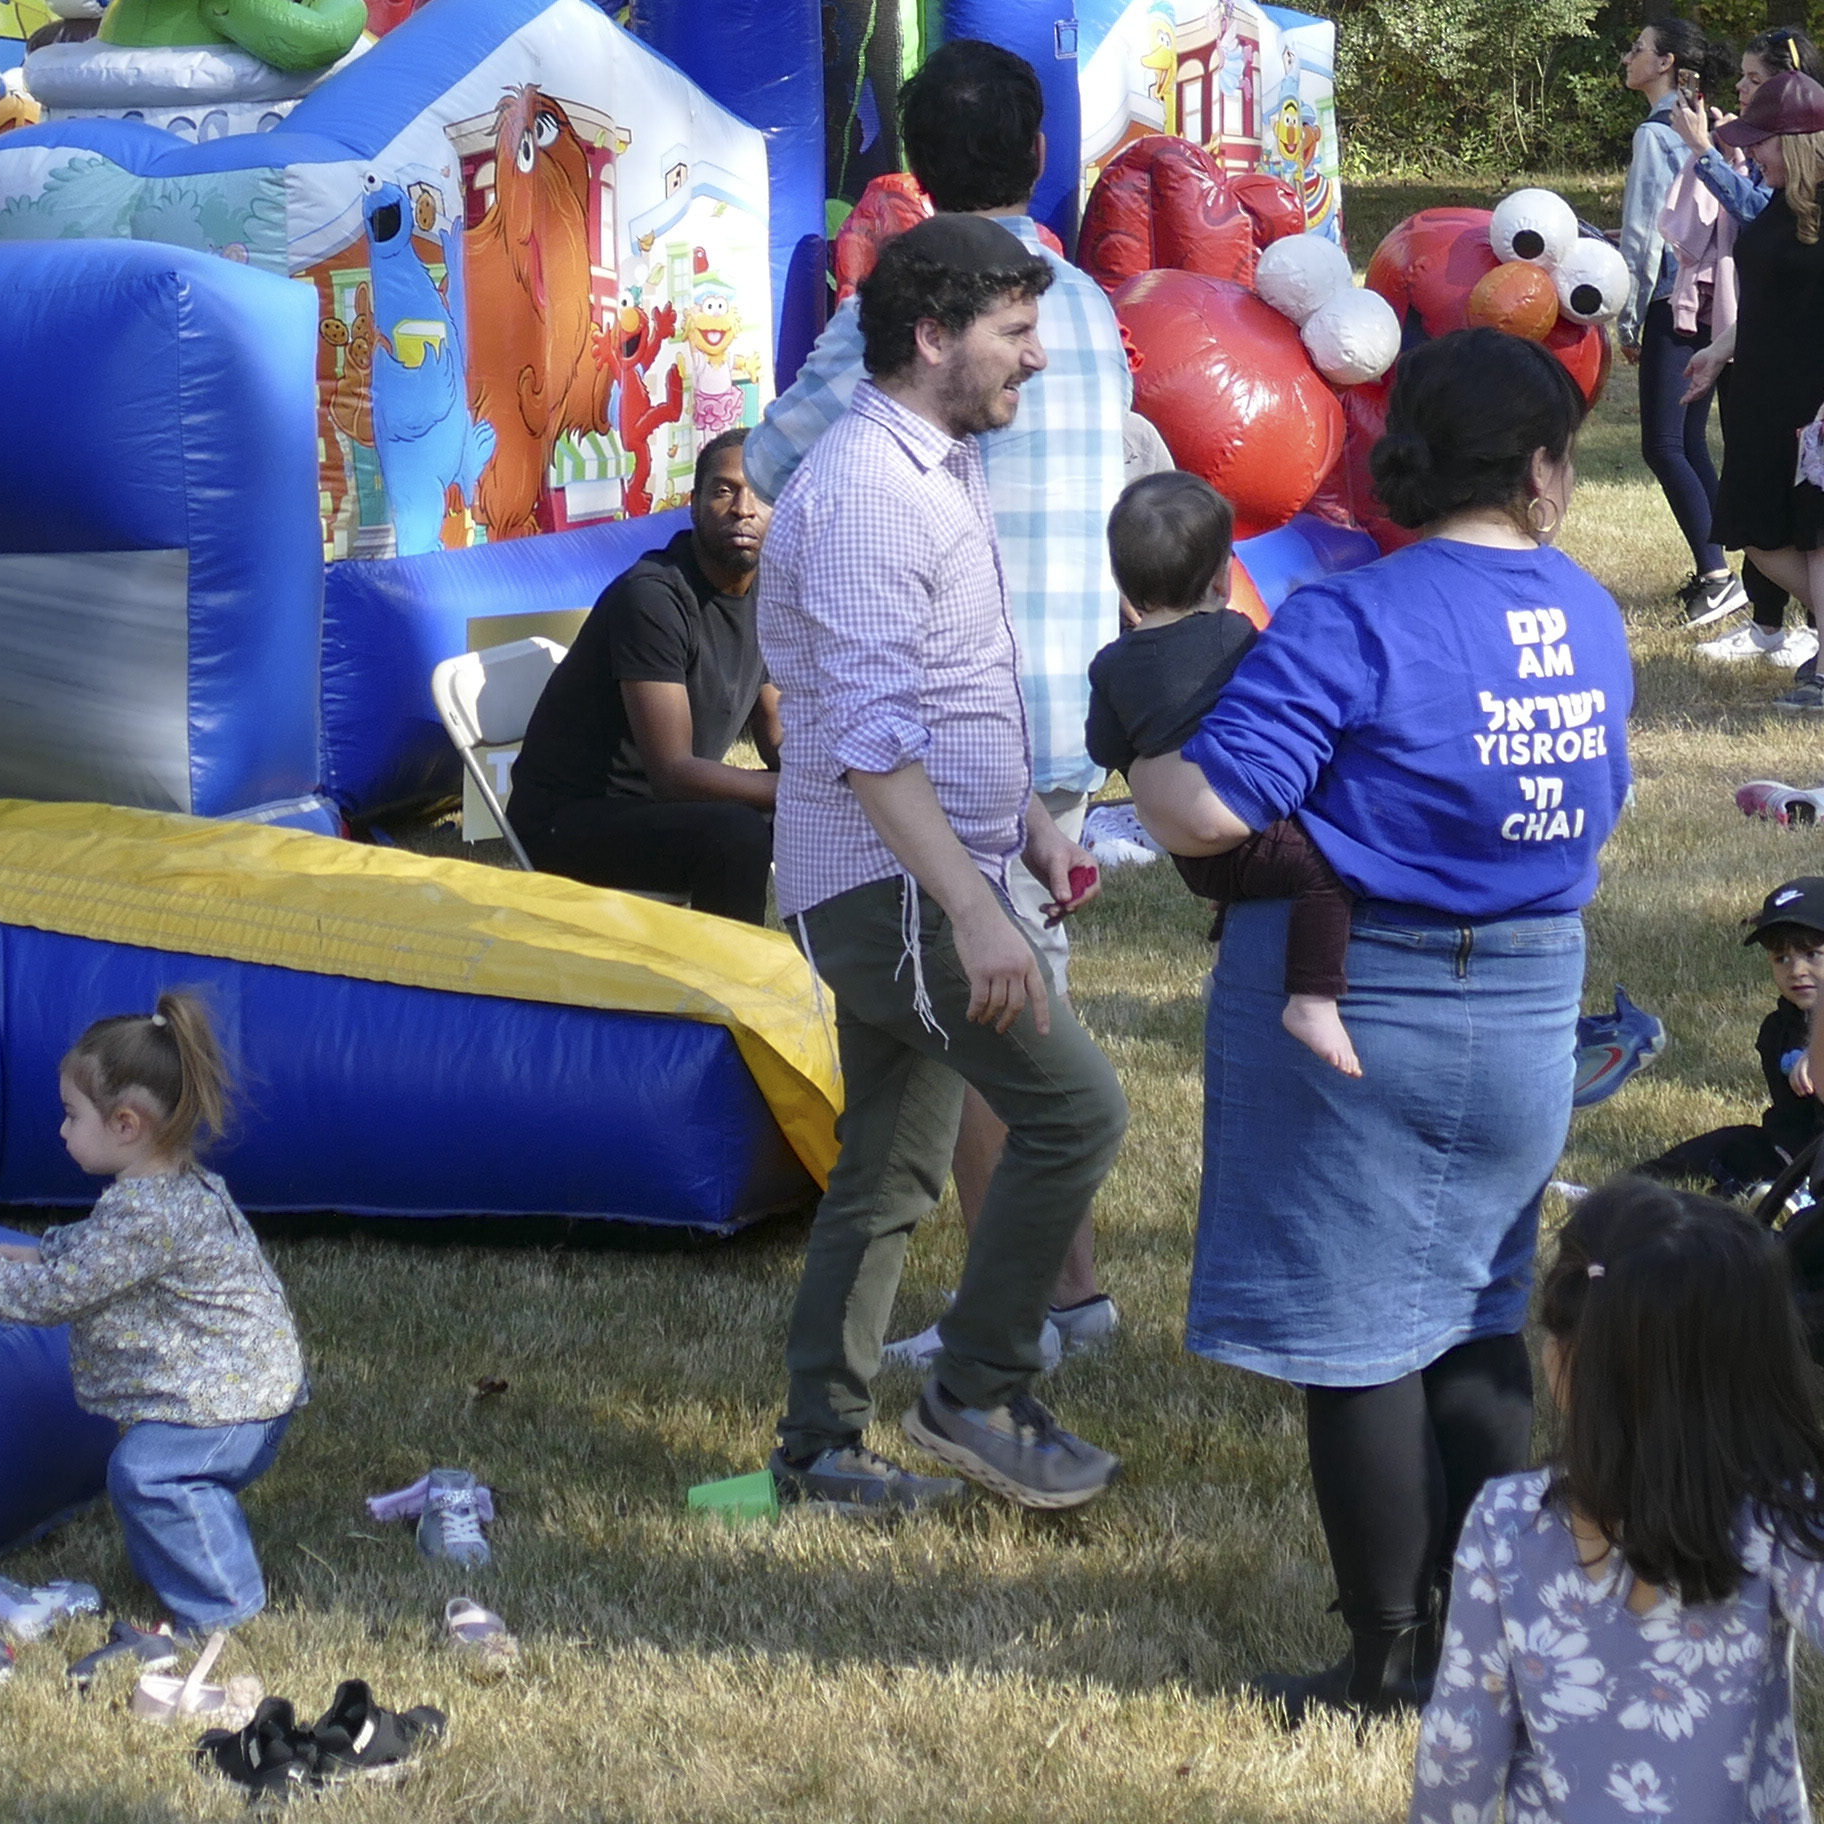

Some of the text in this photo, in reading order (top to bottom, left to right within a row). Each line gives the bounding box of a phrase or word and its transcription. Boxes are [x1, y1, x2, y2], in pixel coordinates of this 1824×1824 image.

[1506, 608, 1567, 646] עם
[1518, 643, 1575, 679] AM
[1479, 689, 1606, 732] ישראל
[1473, 725, 1607, 765] YISROEL
[1519, 776, 1564, 811] חי
[1501, 808, 1585, 842] CHAI
